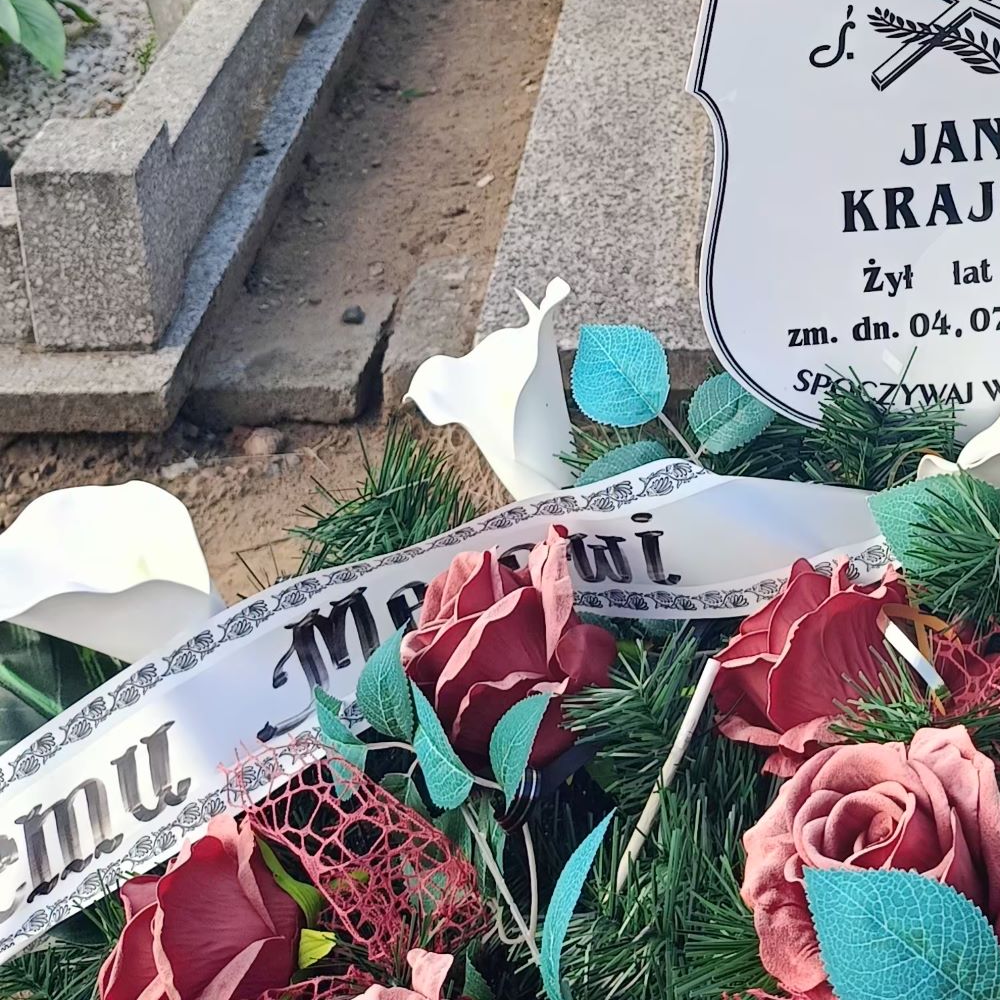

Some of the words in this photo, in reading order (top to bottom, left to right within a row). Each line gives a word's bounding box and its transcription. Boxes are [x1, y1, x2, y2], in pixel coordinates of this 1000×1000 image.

[863, 258, 913, 297] Żył
[952, 258, 993, 285] lat
[788, 324, 838, 347] zm.
[852, 316, 900, 342] dn.
